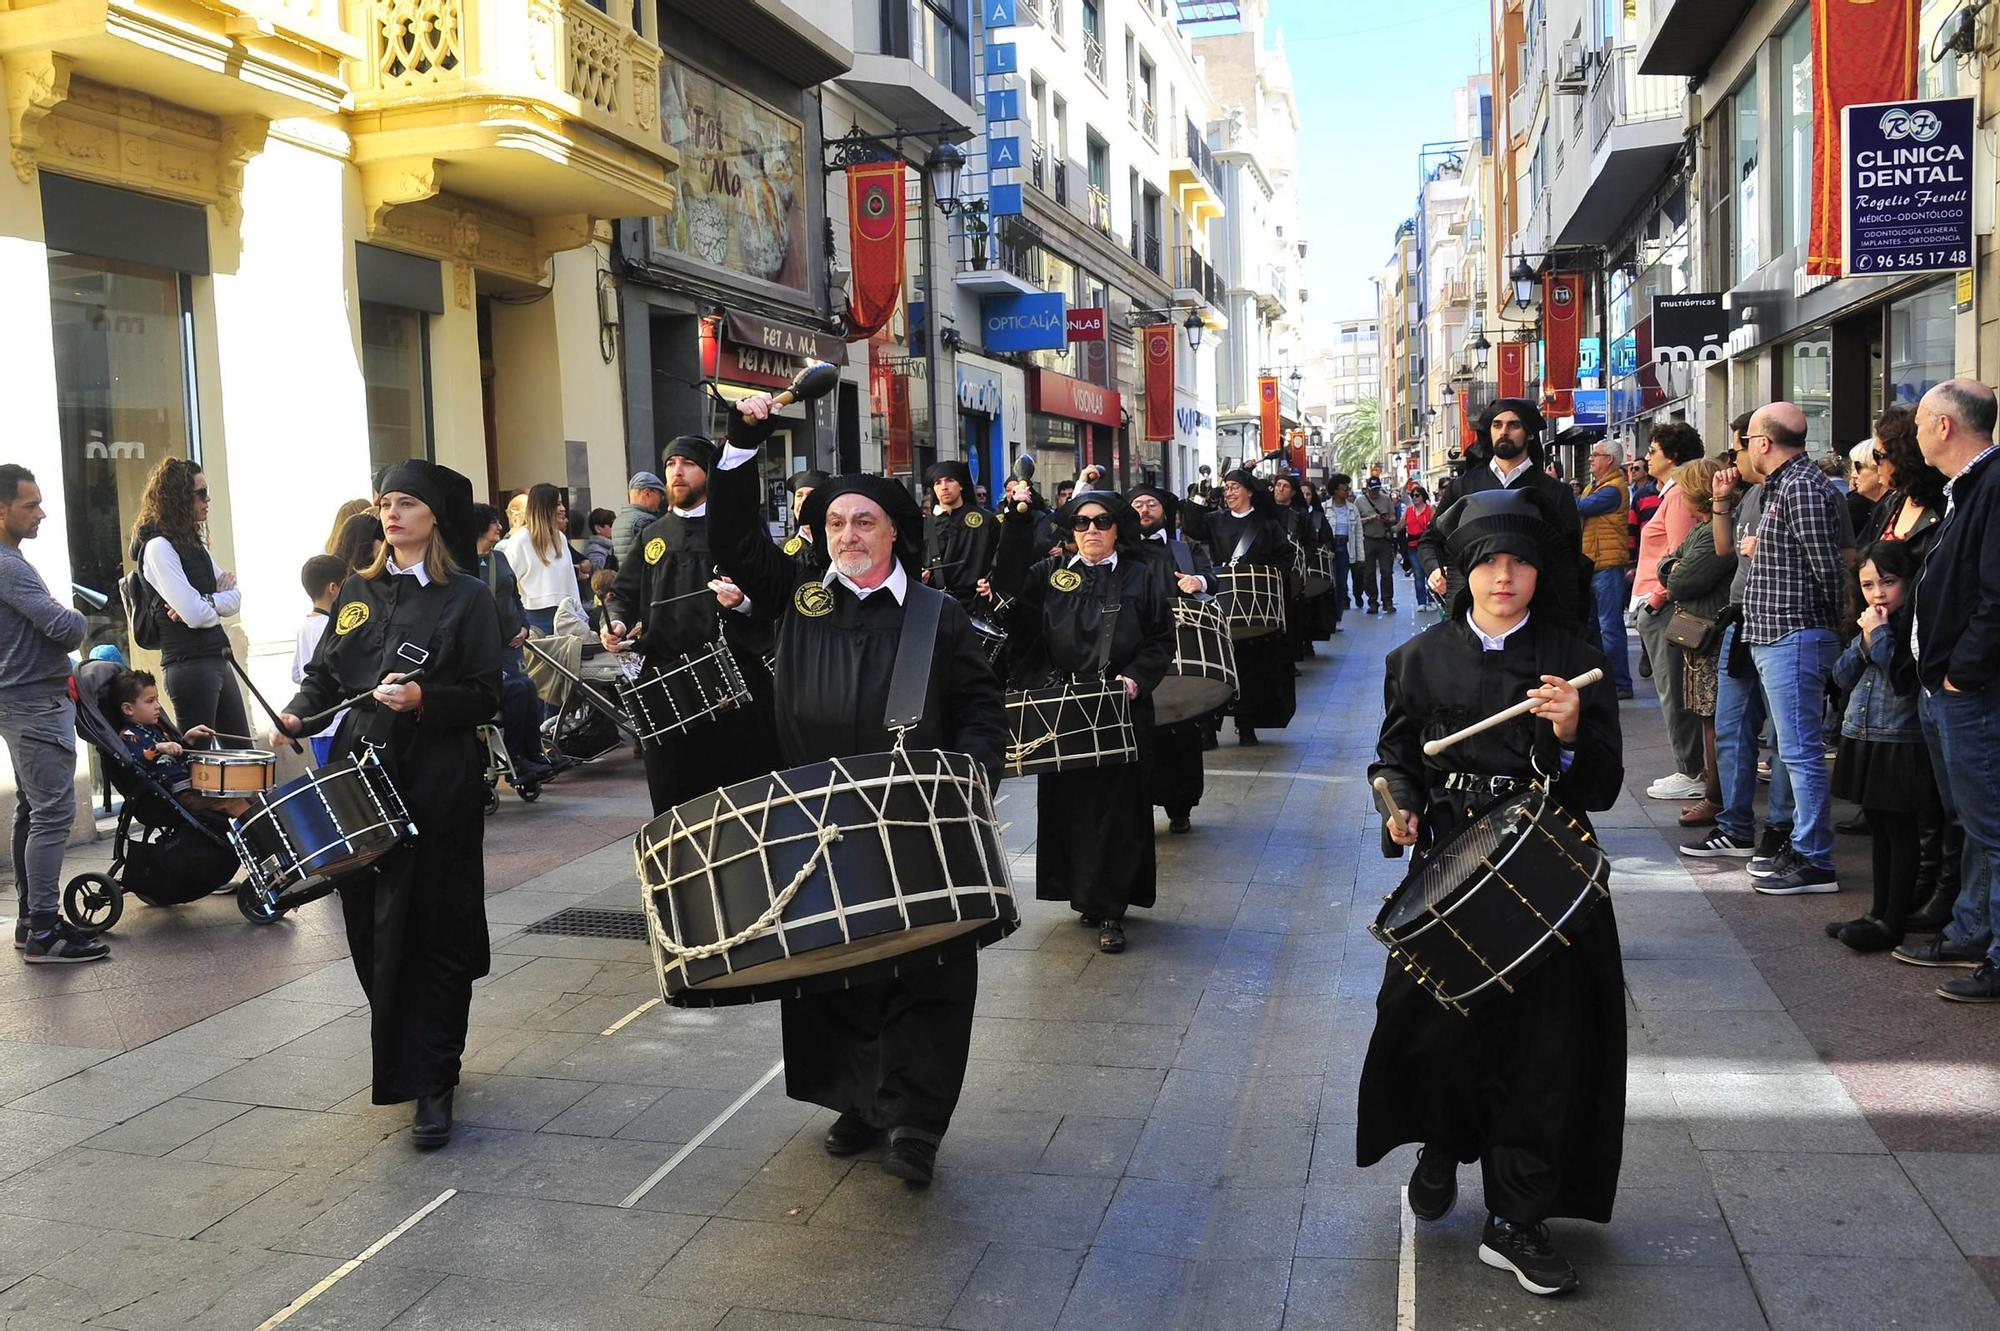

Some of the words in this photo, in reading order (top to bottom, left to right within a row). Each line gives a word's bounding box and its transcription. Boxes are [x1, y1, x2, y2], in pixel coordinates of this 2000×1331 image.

[1856, 145, 1965, 168] CLINICA
[1858, 165, 1963, 189] DENTAL
[1856, 194, 1910, 210] Rogelio
[1914, 190, 1967, 207] Fenoll
[1923, 226, 1958, 235] GENERAL
[1861, 239, 1901, 247] IMPLANTES
[1908, 235, 1960, 244] ORTODONCIA
[1877, 255, 1893, 267] 96
[1898, 253, 1923, 267] 545
[1929, 252, 1945, 264] 17
[1949, 250, 1966, 263] 48
[763, 326, 782, 347] FET
[785, 332, 794, 350] A
